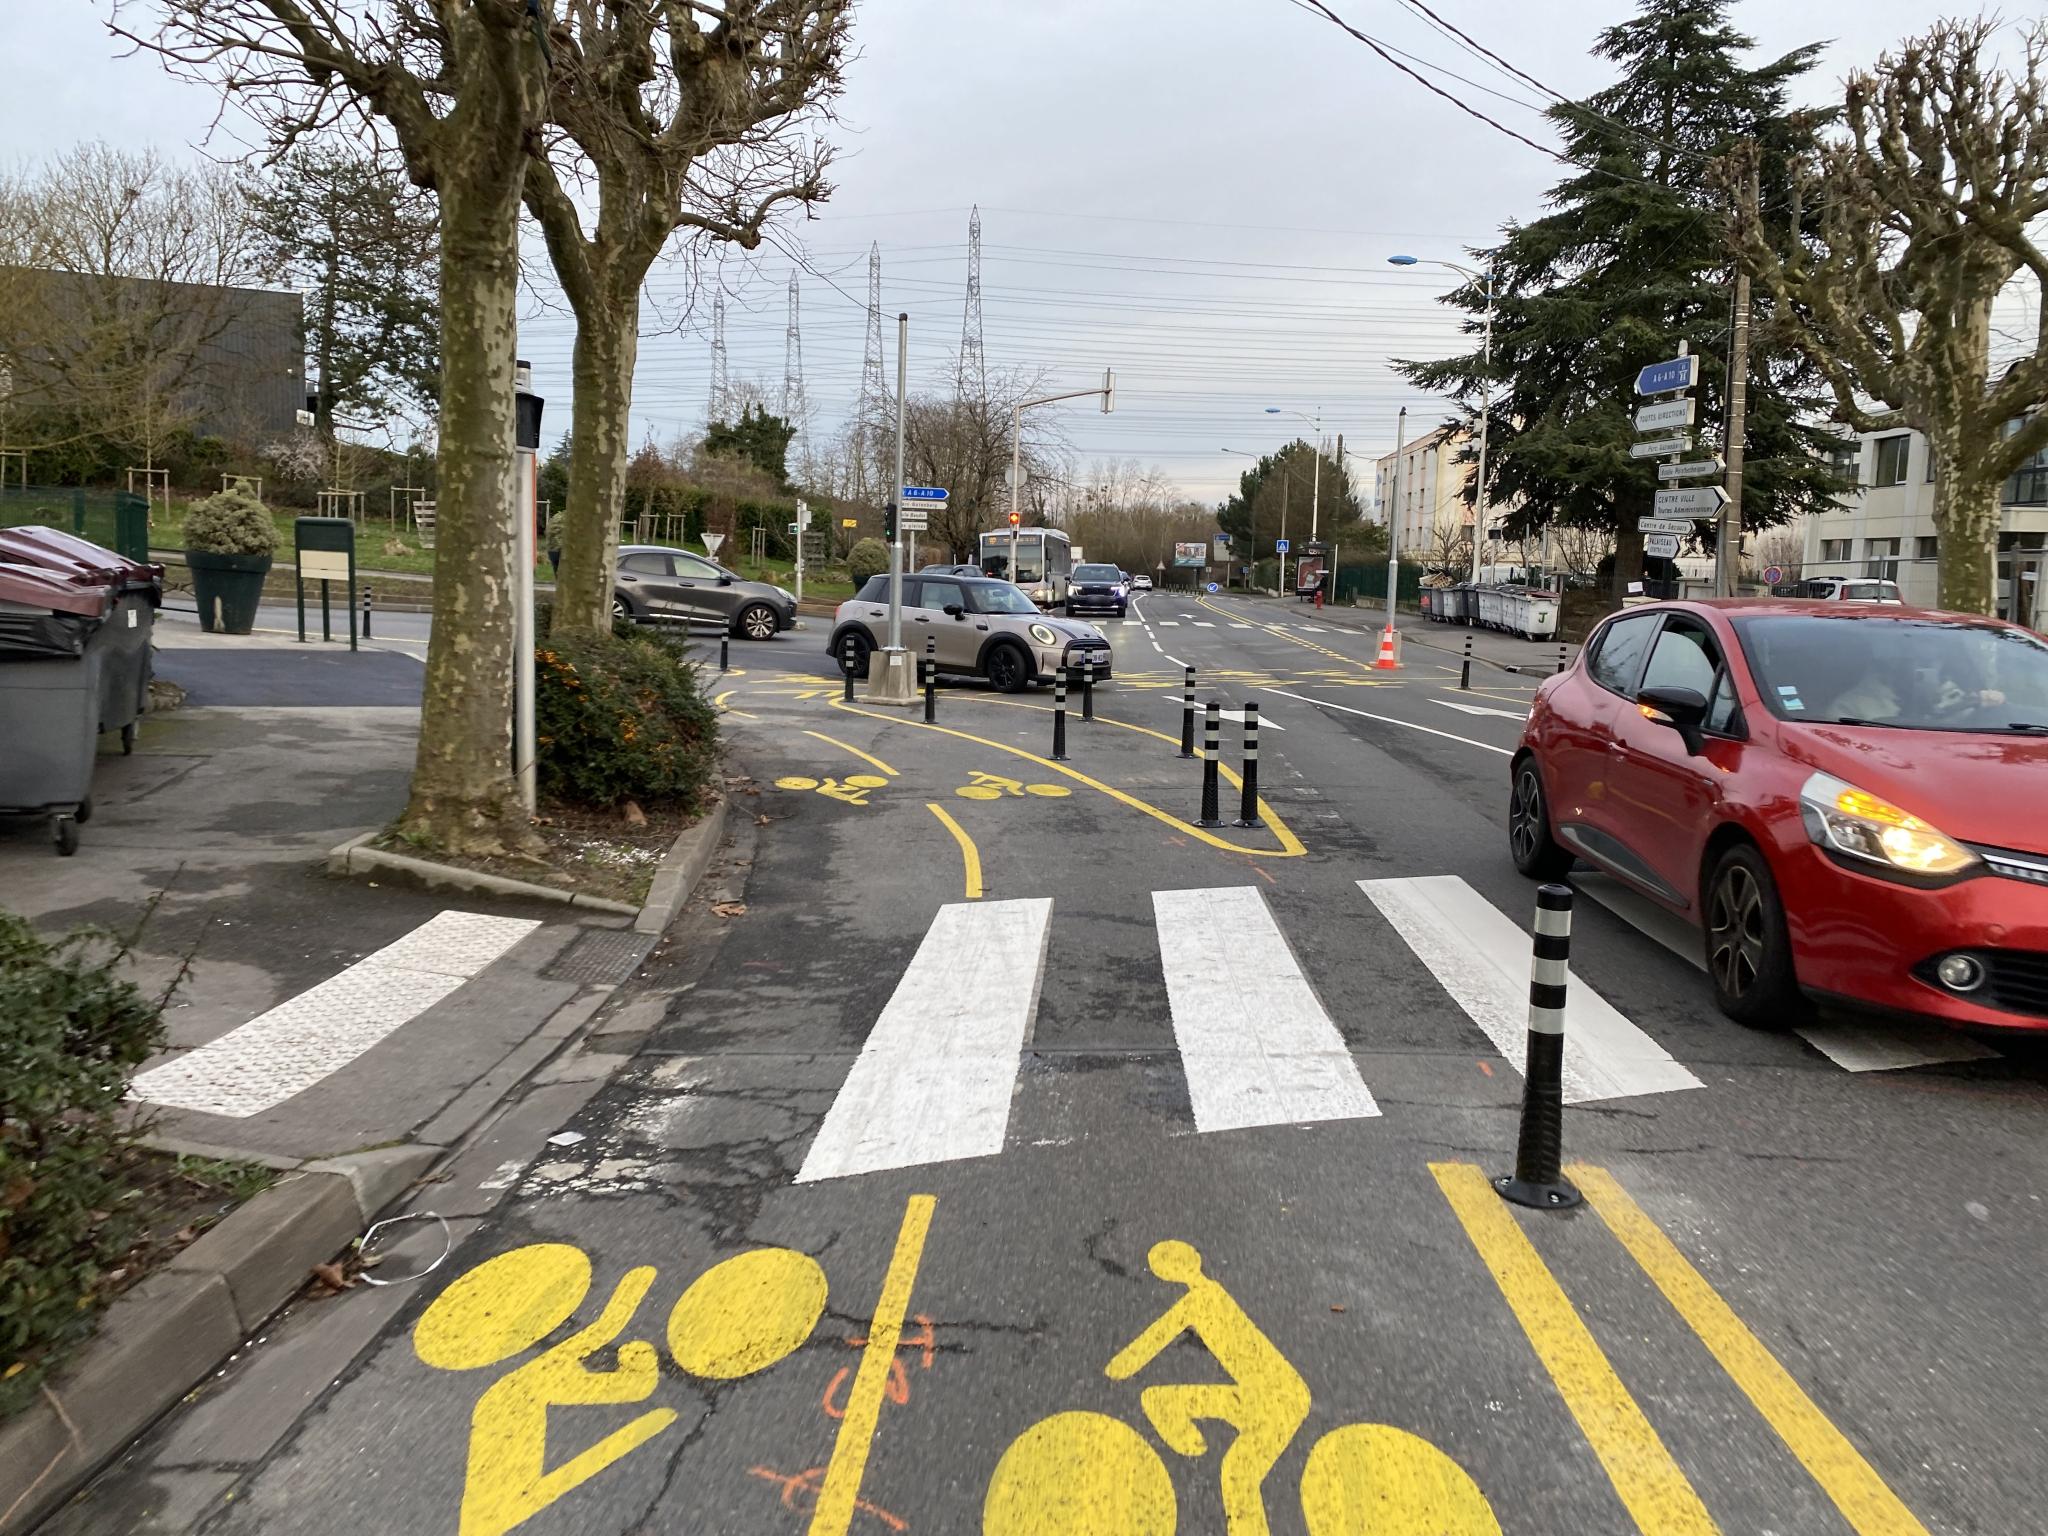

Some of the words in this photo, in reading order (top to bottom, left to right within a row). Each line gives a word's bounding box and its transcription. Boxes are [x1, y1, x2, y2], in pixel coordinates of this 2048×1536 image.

[1640, 413, 1656, 423] TOUTES
[1657, 409, 1686, 420] DIRECTIONS
[1658, 495, 1679, 504] CENTRE
[1680, 495, 1695, 503] VILLE
[1640, 520, 1657, 529] Centre
[1658, 522, 1666, 530] de
[1649, 538, 1673, 546] PALAISEAU
[1538, 612, 1548, 623] J
